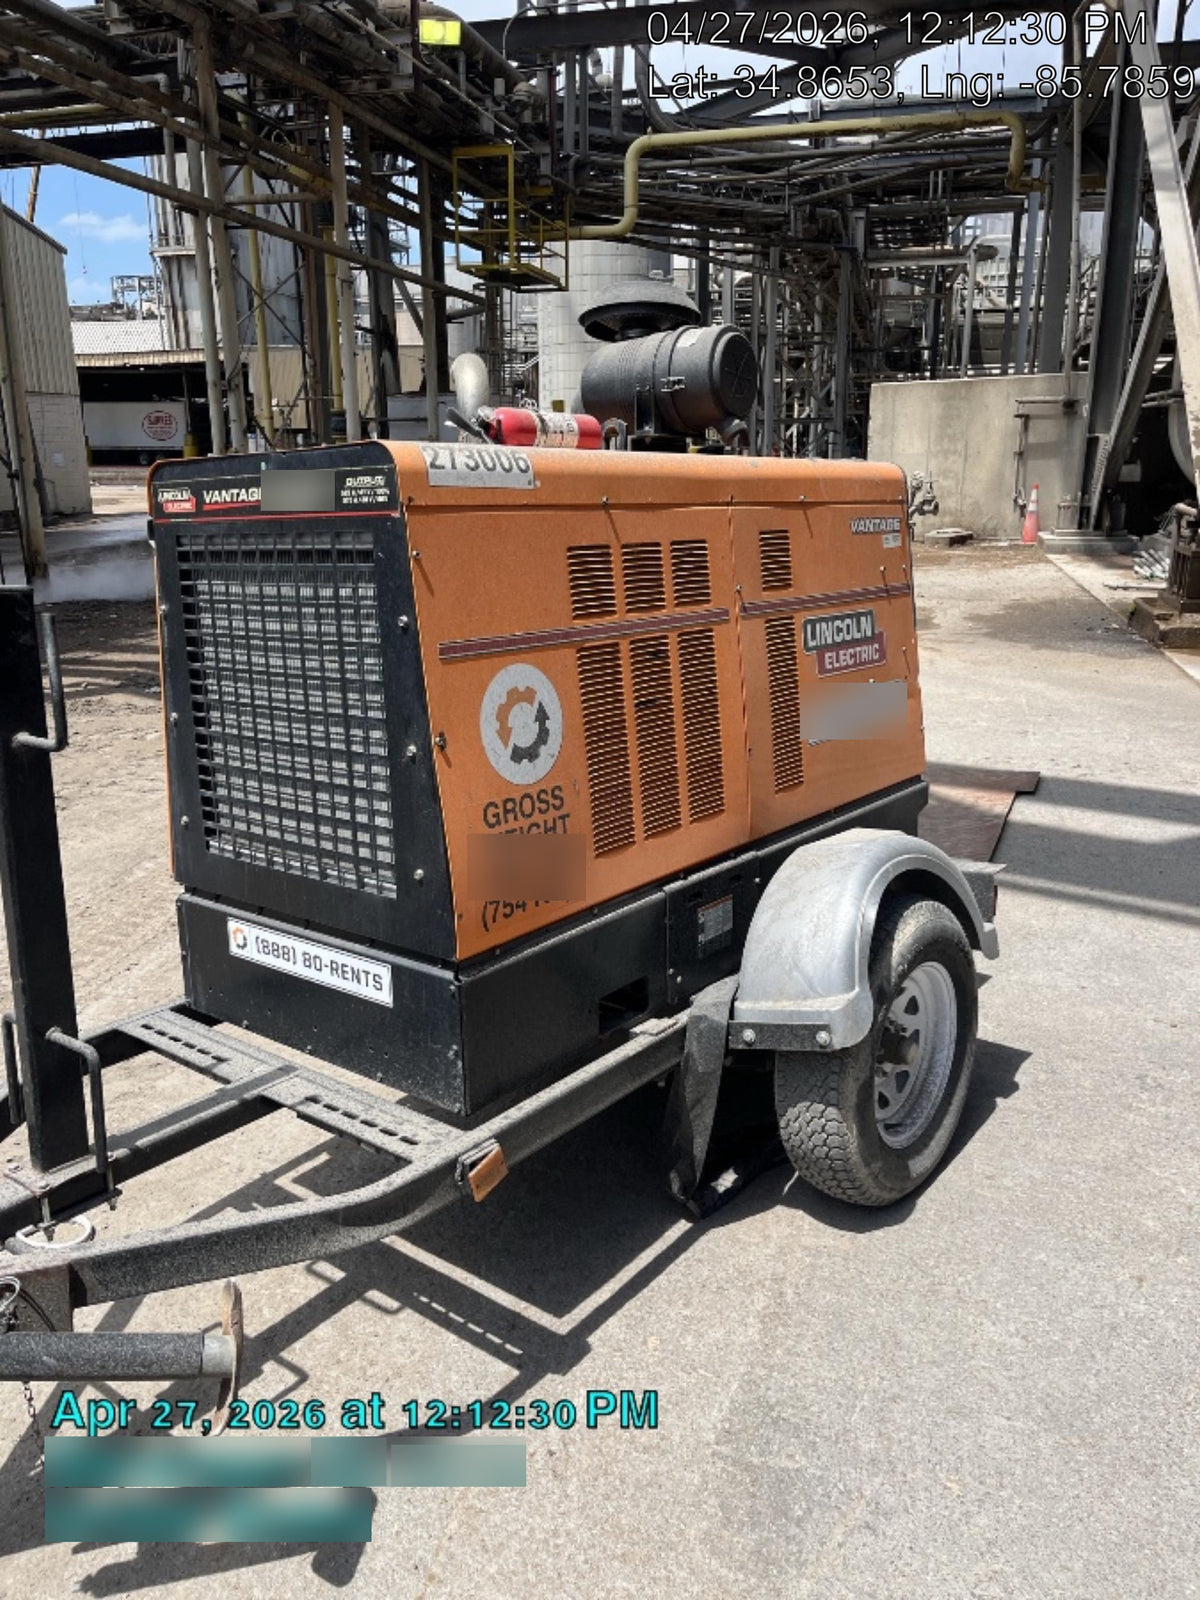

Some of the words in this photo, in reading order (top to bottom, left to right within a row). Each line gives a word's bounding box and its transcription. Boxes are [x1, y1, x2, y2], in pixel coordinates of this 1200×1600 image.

[421, 446, 531, 473] 273006
[851, 517, 901, 533] VANTAGE
[806, 614, 873, 647] LINCOLN
[824, 643, 880, 670] ELECTRIC
[483, 785, 564, 829] GROSS
[255, 936, 297, 965] (888)
[302, 951, 383, 991] 80-RENTS
